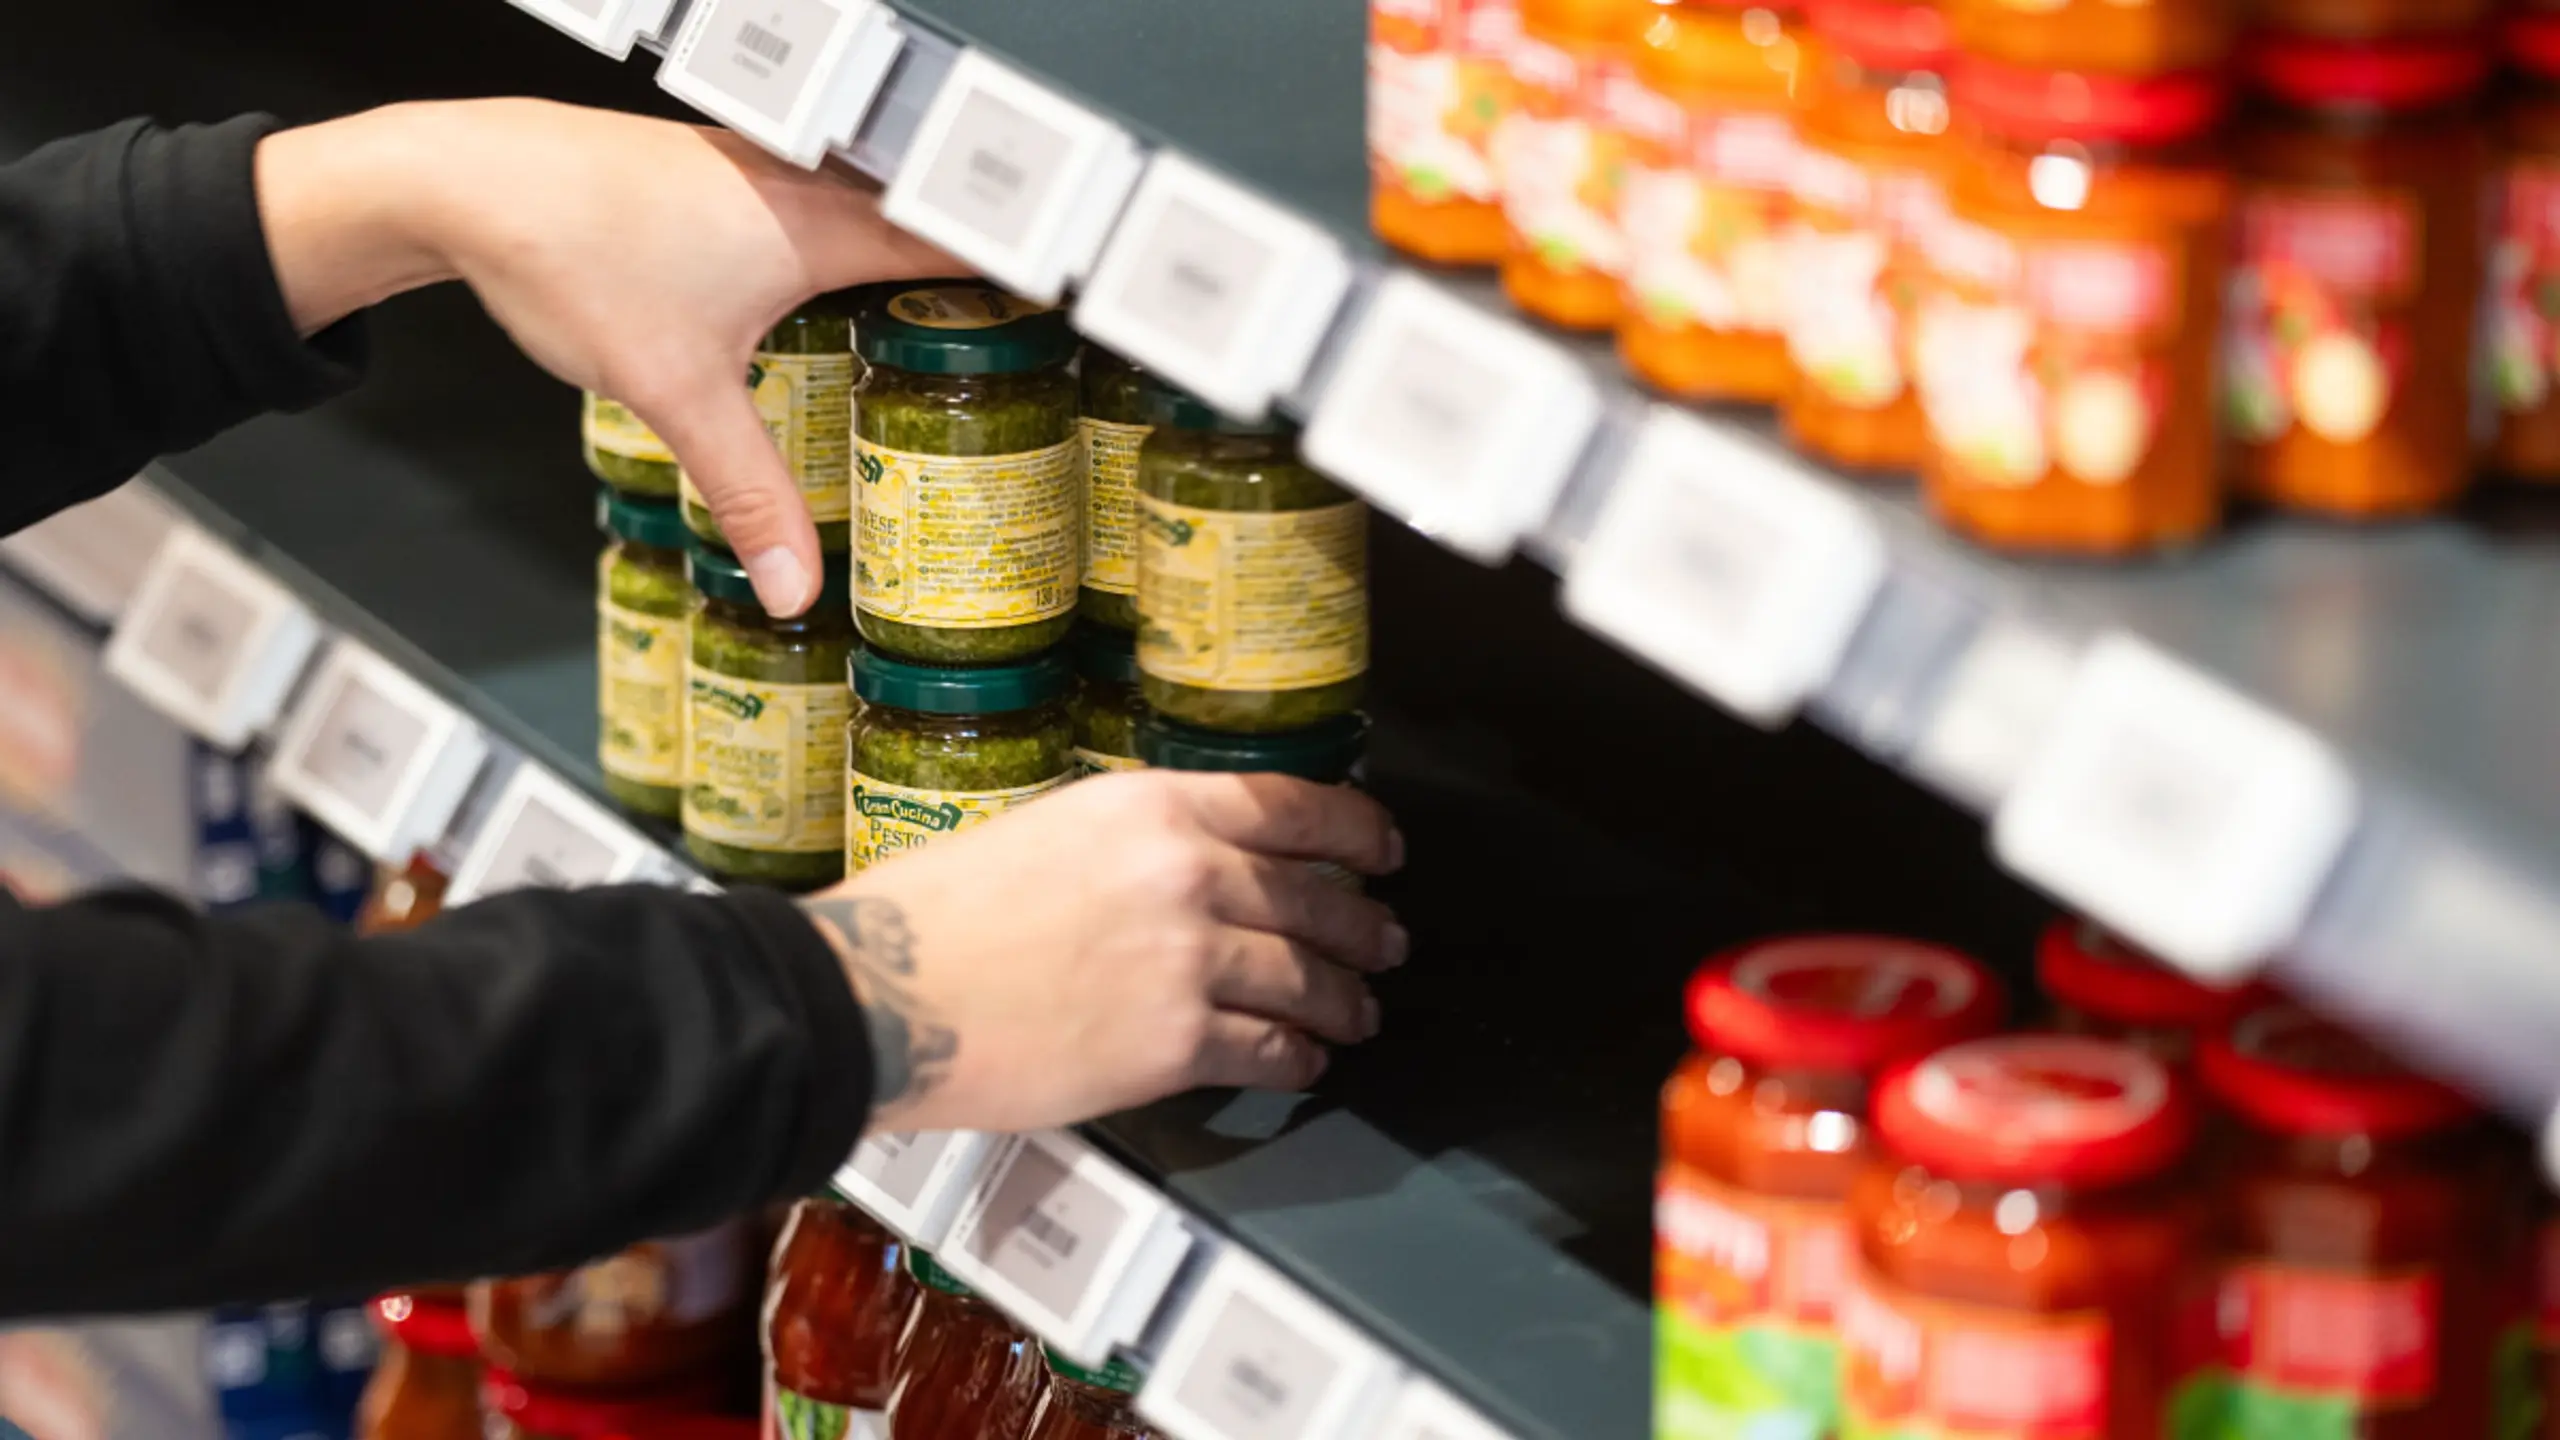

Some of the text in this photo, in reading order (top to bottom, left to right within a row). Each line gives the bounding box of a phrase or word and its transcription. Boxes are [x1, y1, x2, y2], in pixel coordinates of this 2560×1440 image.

[862, 796, 941, 829] Gran Cucina
[870, 819, 928, 850] PESTO
